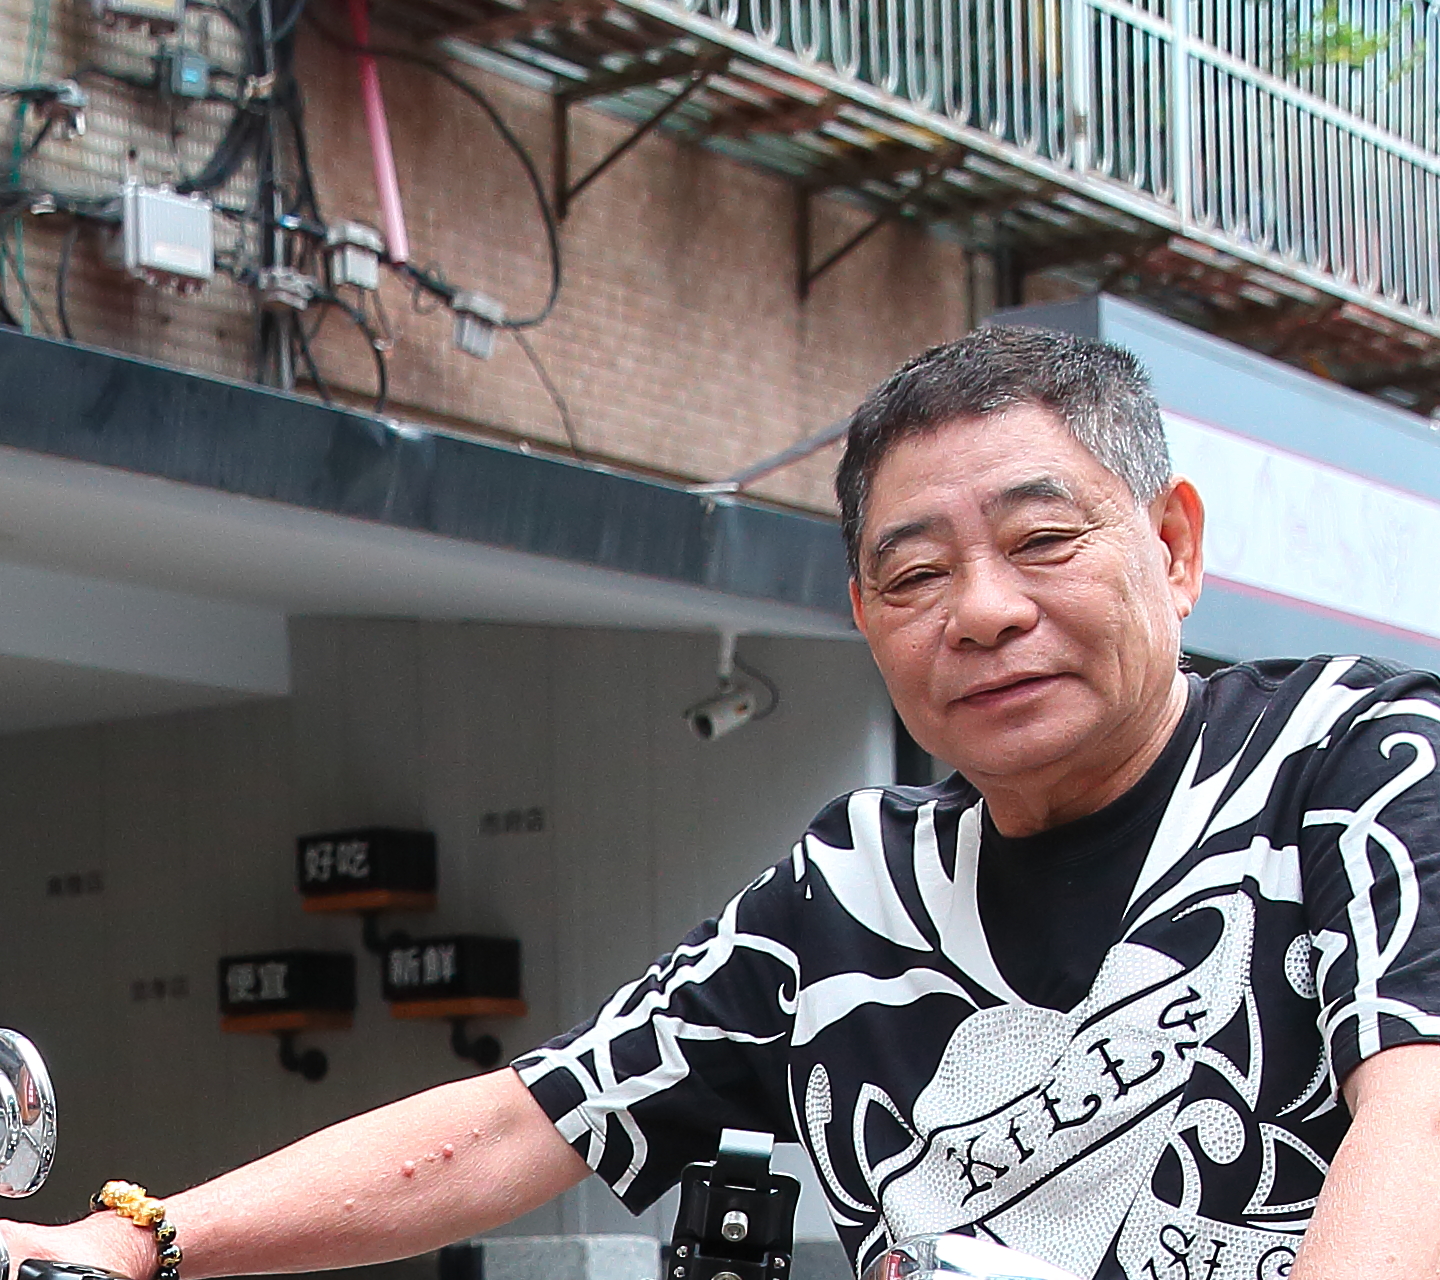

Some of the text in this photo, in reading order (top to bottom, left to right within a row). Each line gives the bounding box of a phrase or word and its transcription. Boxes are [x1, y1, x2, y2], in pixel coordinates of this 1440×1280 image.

[303, 840, 371, 882] 好吃
[226, 961, 289, 1004] 便宜
[387, 943, 457, 987] 新鮮
